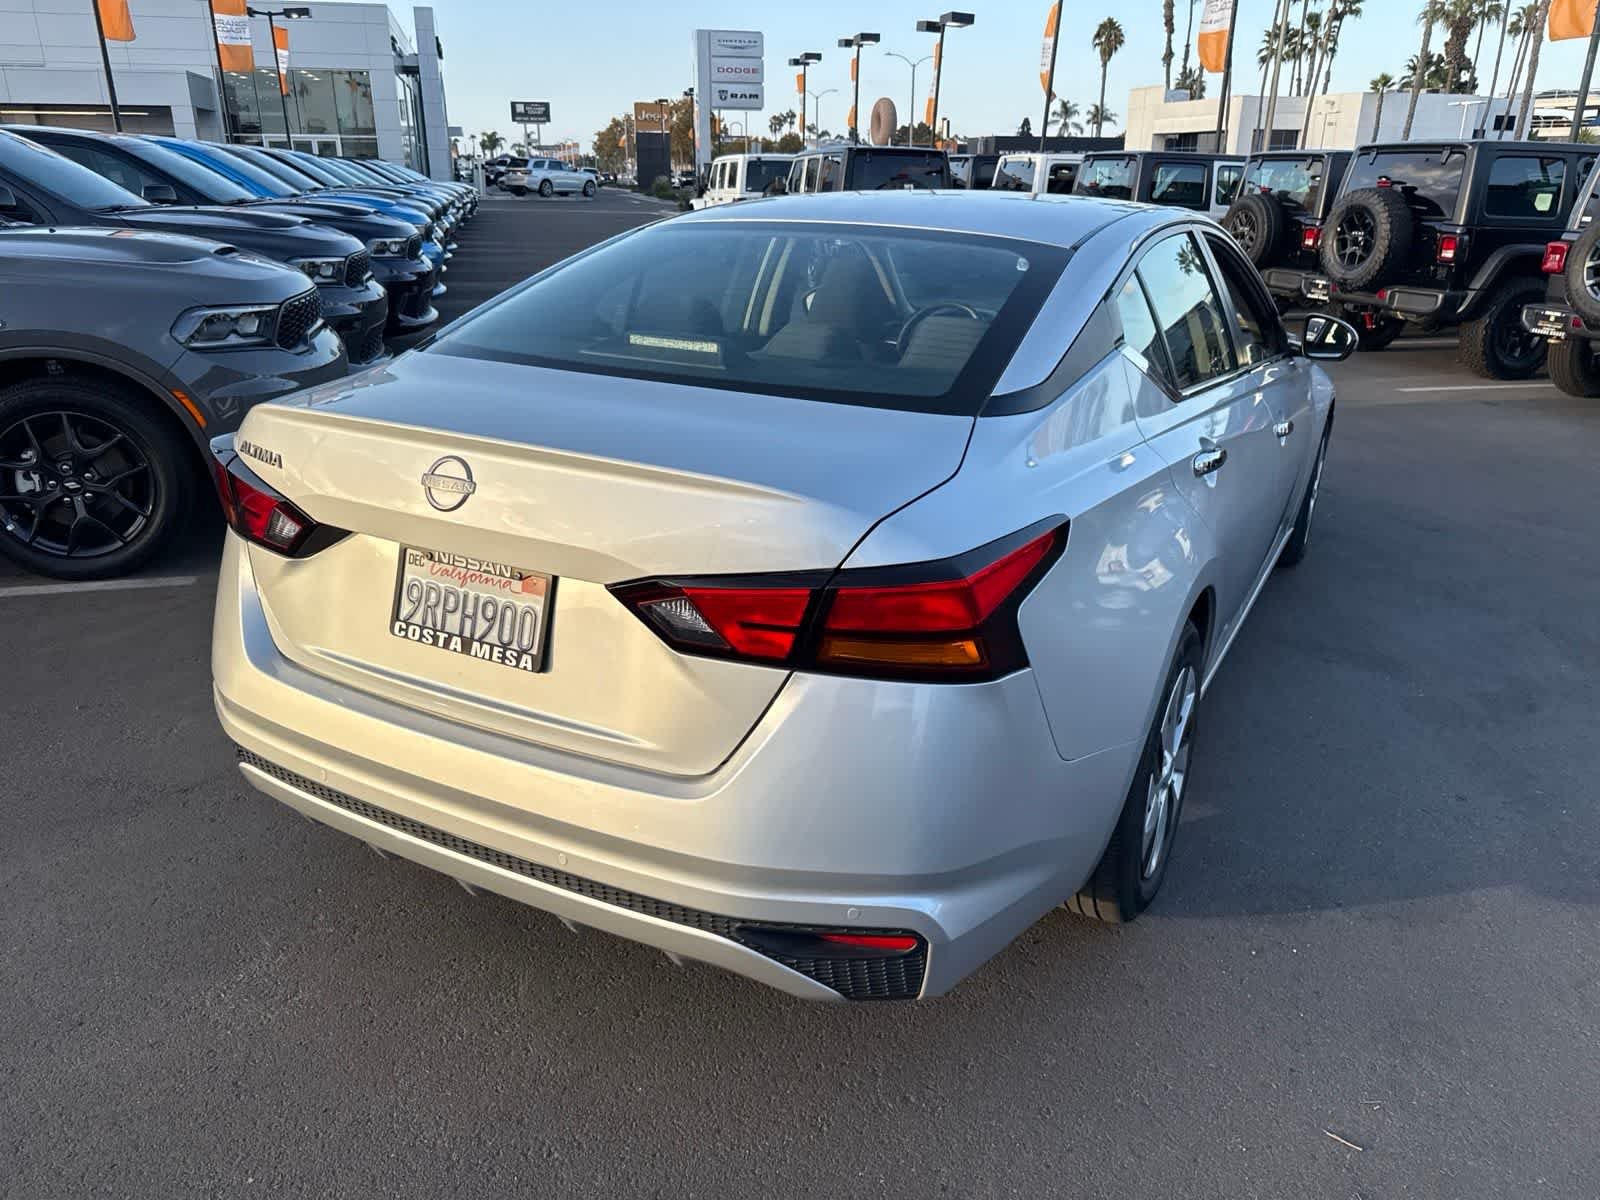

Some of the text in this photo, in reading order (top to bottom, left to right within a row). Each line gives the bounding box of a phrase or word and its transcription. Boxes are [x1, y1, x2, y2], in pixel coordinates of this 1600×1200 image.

[717, 66, 760, 74] DODGE
[638, 110, 668, 122] Jeep
[240, 440, 283, 469] ALTIMA
[423, 475, 474, 494] NISSAN
[408, 552, 425, 567] DEC
[435, 551, 512, 578] NISSAN
[429, 562, 524, 595] California
[402, 577, 538, 653] 9RPH900
[393, 620, 533, 672] COSTA MESA
